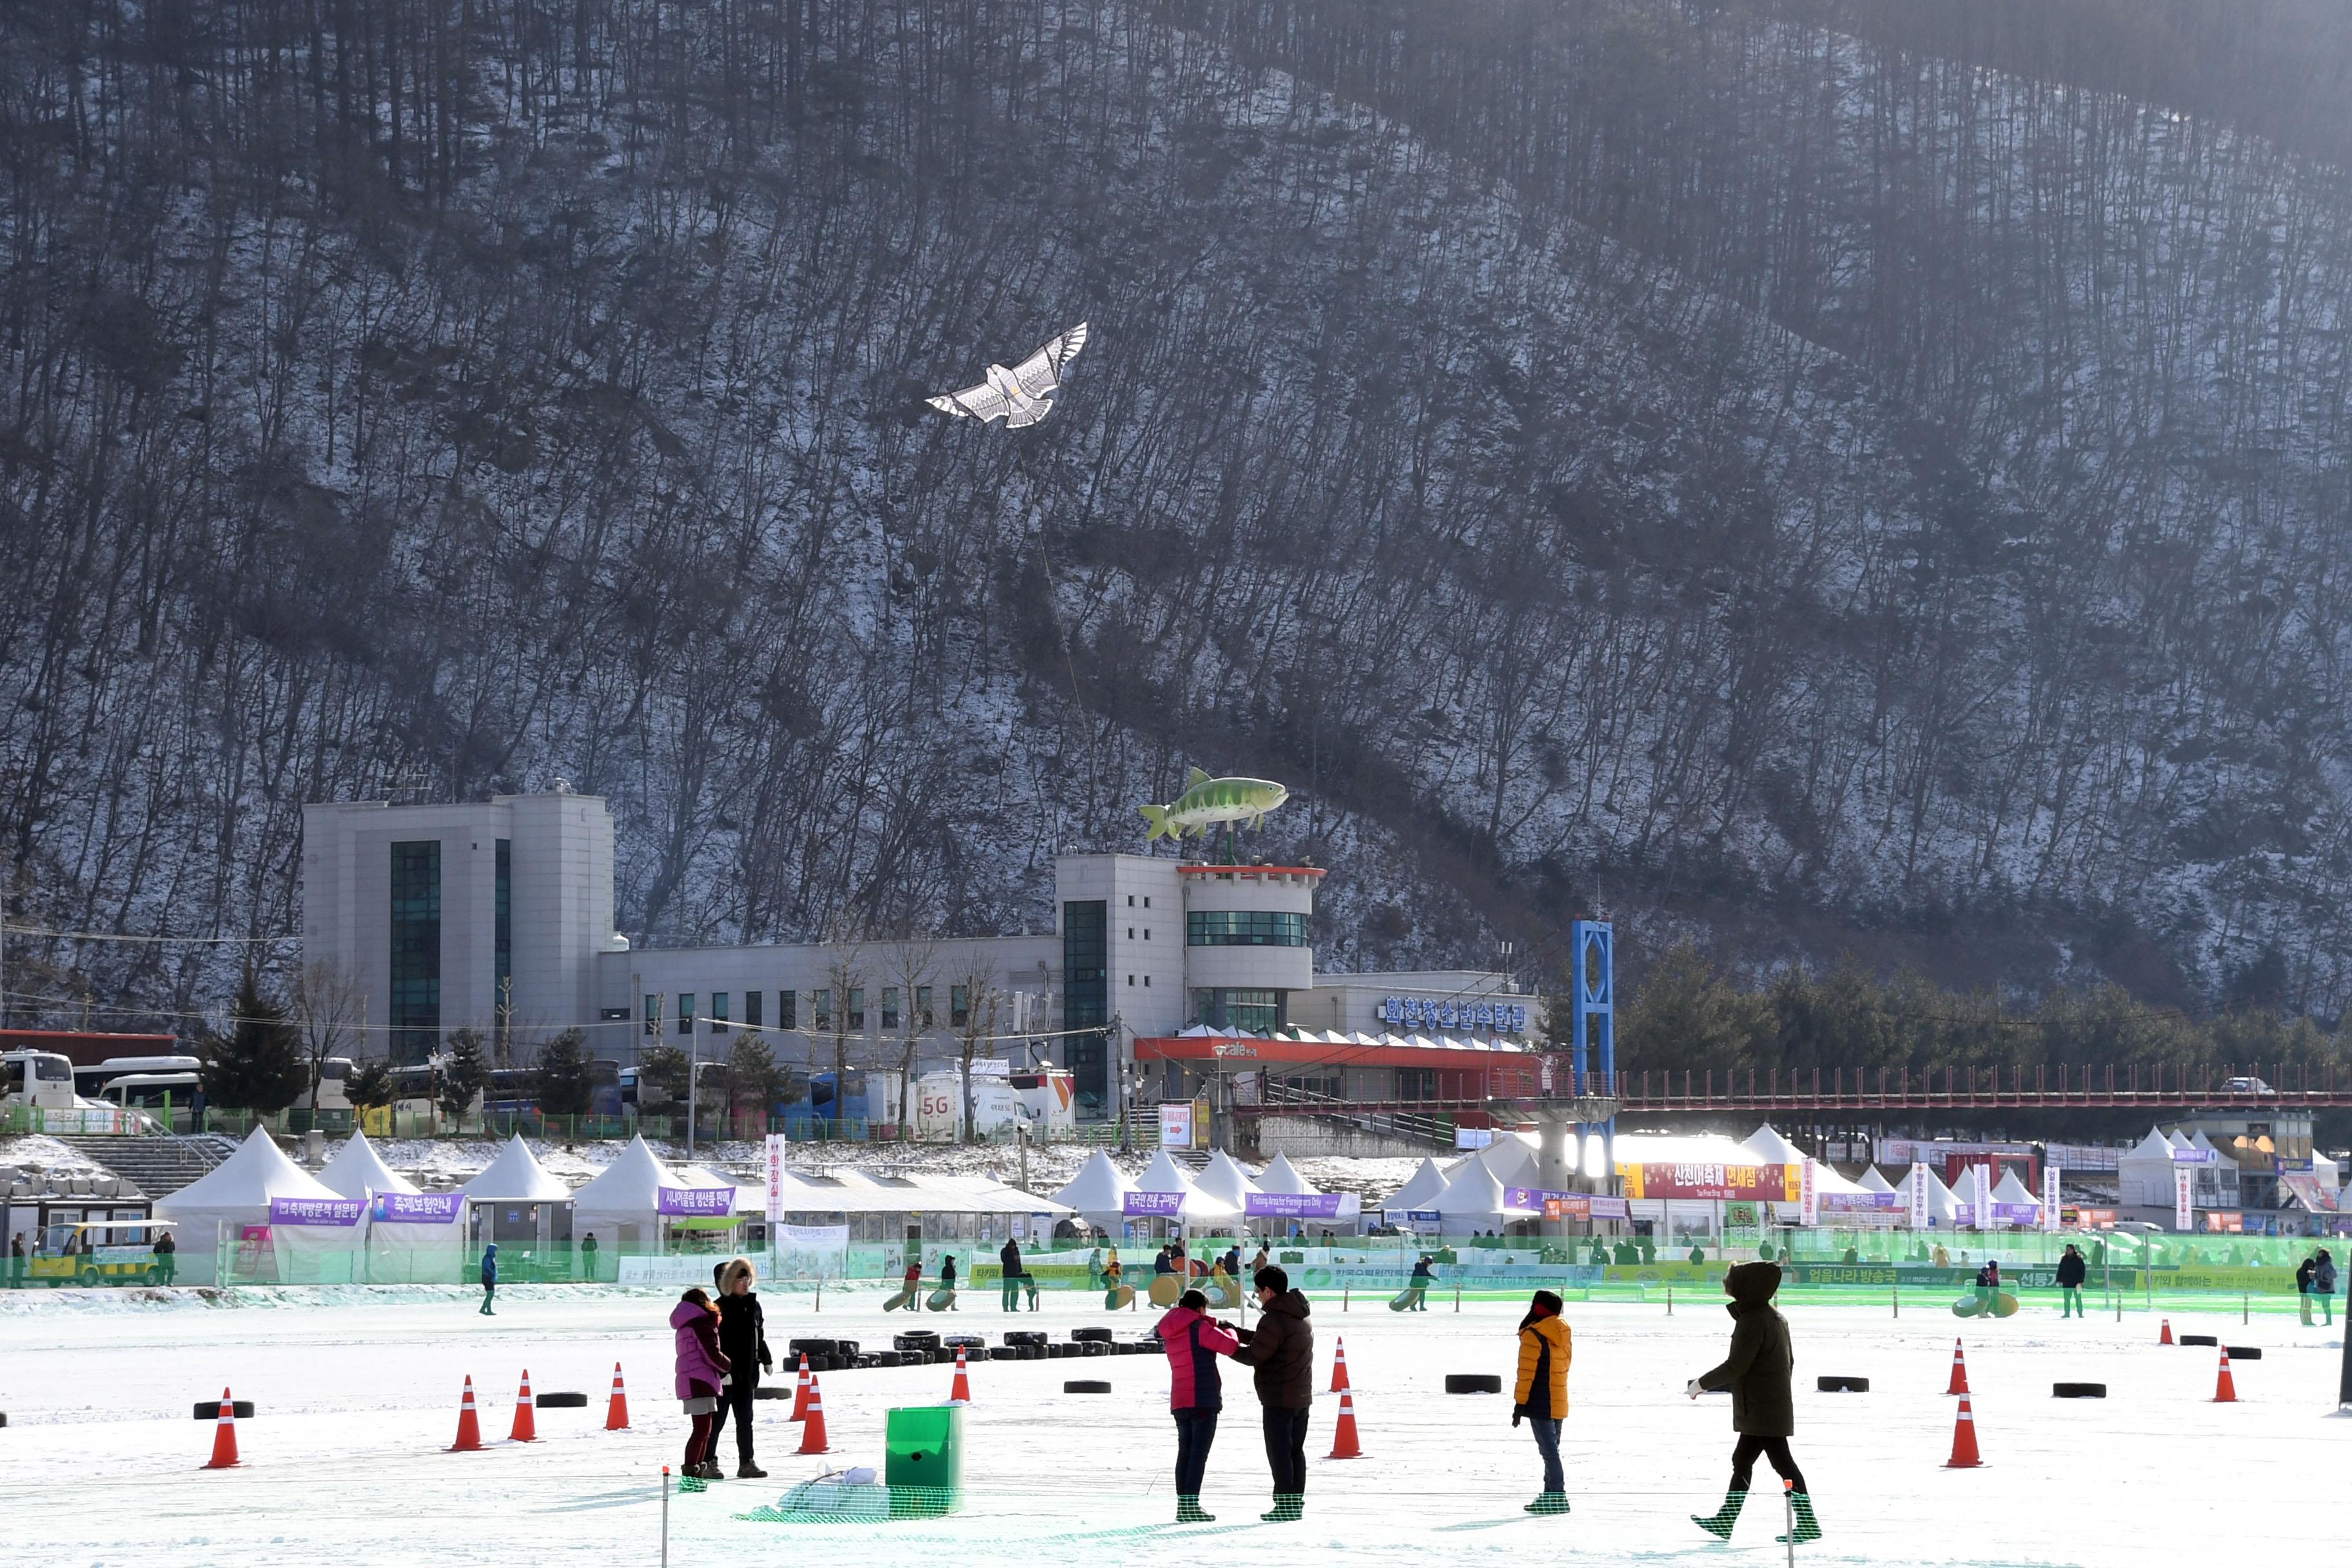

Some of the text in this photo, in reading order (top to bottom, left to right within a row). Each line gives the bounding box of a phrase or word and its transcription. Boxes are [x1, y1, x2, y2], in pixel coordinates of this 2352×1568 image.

[1386, 996, 1526, 1032] 화천청소년수련관
[1224, 1041, 1245, 1056] cafe
[923, 1096, 948, 1115] 5G
[770, 1154, 779, 1197] 화장실
[1674, 1164, 1756, 1188] 산천어축제 면세점
[393, 1195, 452, 1214] 축제보험안내
[666, 1190, 730, 1208] 시니어클럽 생산품 판매
[1128, 1193, 1179, 1208] 외국인 전용 구이터
[1252, 1195, 1268, 1208] Fishing
[1268, 1196, 1279, 1206] Area
[1286, 1196, 1311, 1209] Foreigners
[1311, 1197, 1322, 1209] Only
[289, 1202, 358, 1219] 축제방문객 설문팀
[976, 1268, 999, 1278] 타키와
[1808, 1269, 1857, 1284] 얼음나라
[1859, 1269, 1897, 1284] 방송국
[2175, 1276, 2211, 1287] 함께하는
